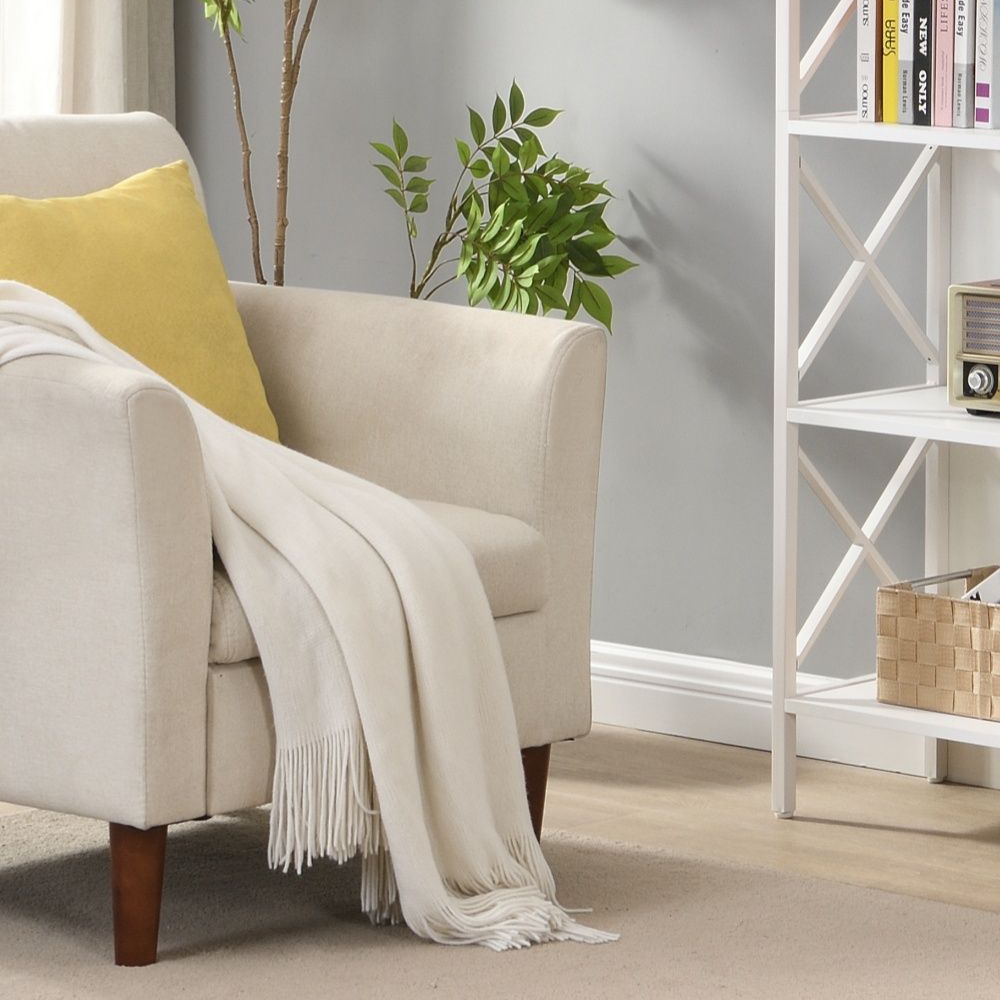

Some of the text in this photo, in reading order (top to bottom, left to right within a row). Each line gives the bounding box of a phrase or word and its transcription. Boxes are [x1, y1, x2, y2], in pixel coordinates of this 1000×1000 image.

[900, 12, 910, 34] Easy
[918, 17, 928, 56] NEW
[956, 15, 966, 37] Easy
[918, 69, 928, 115] ONLY
